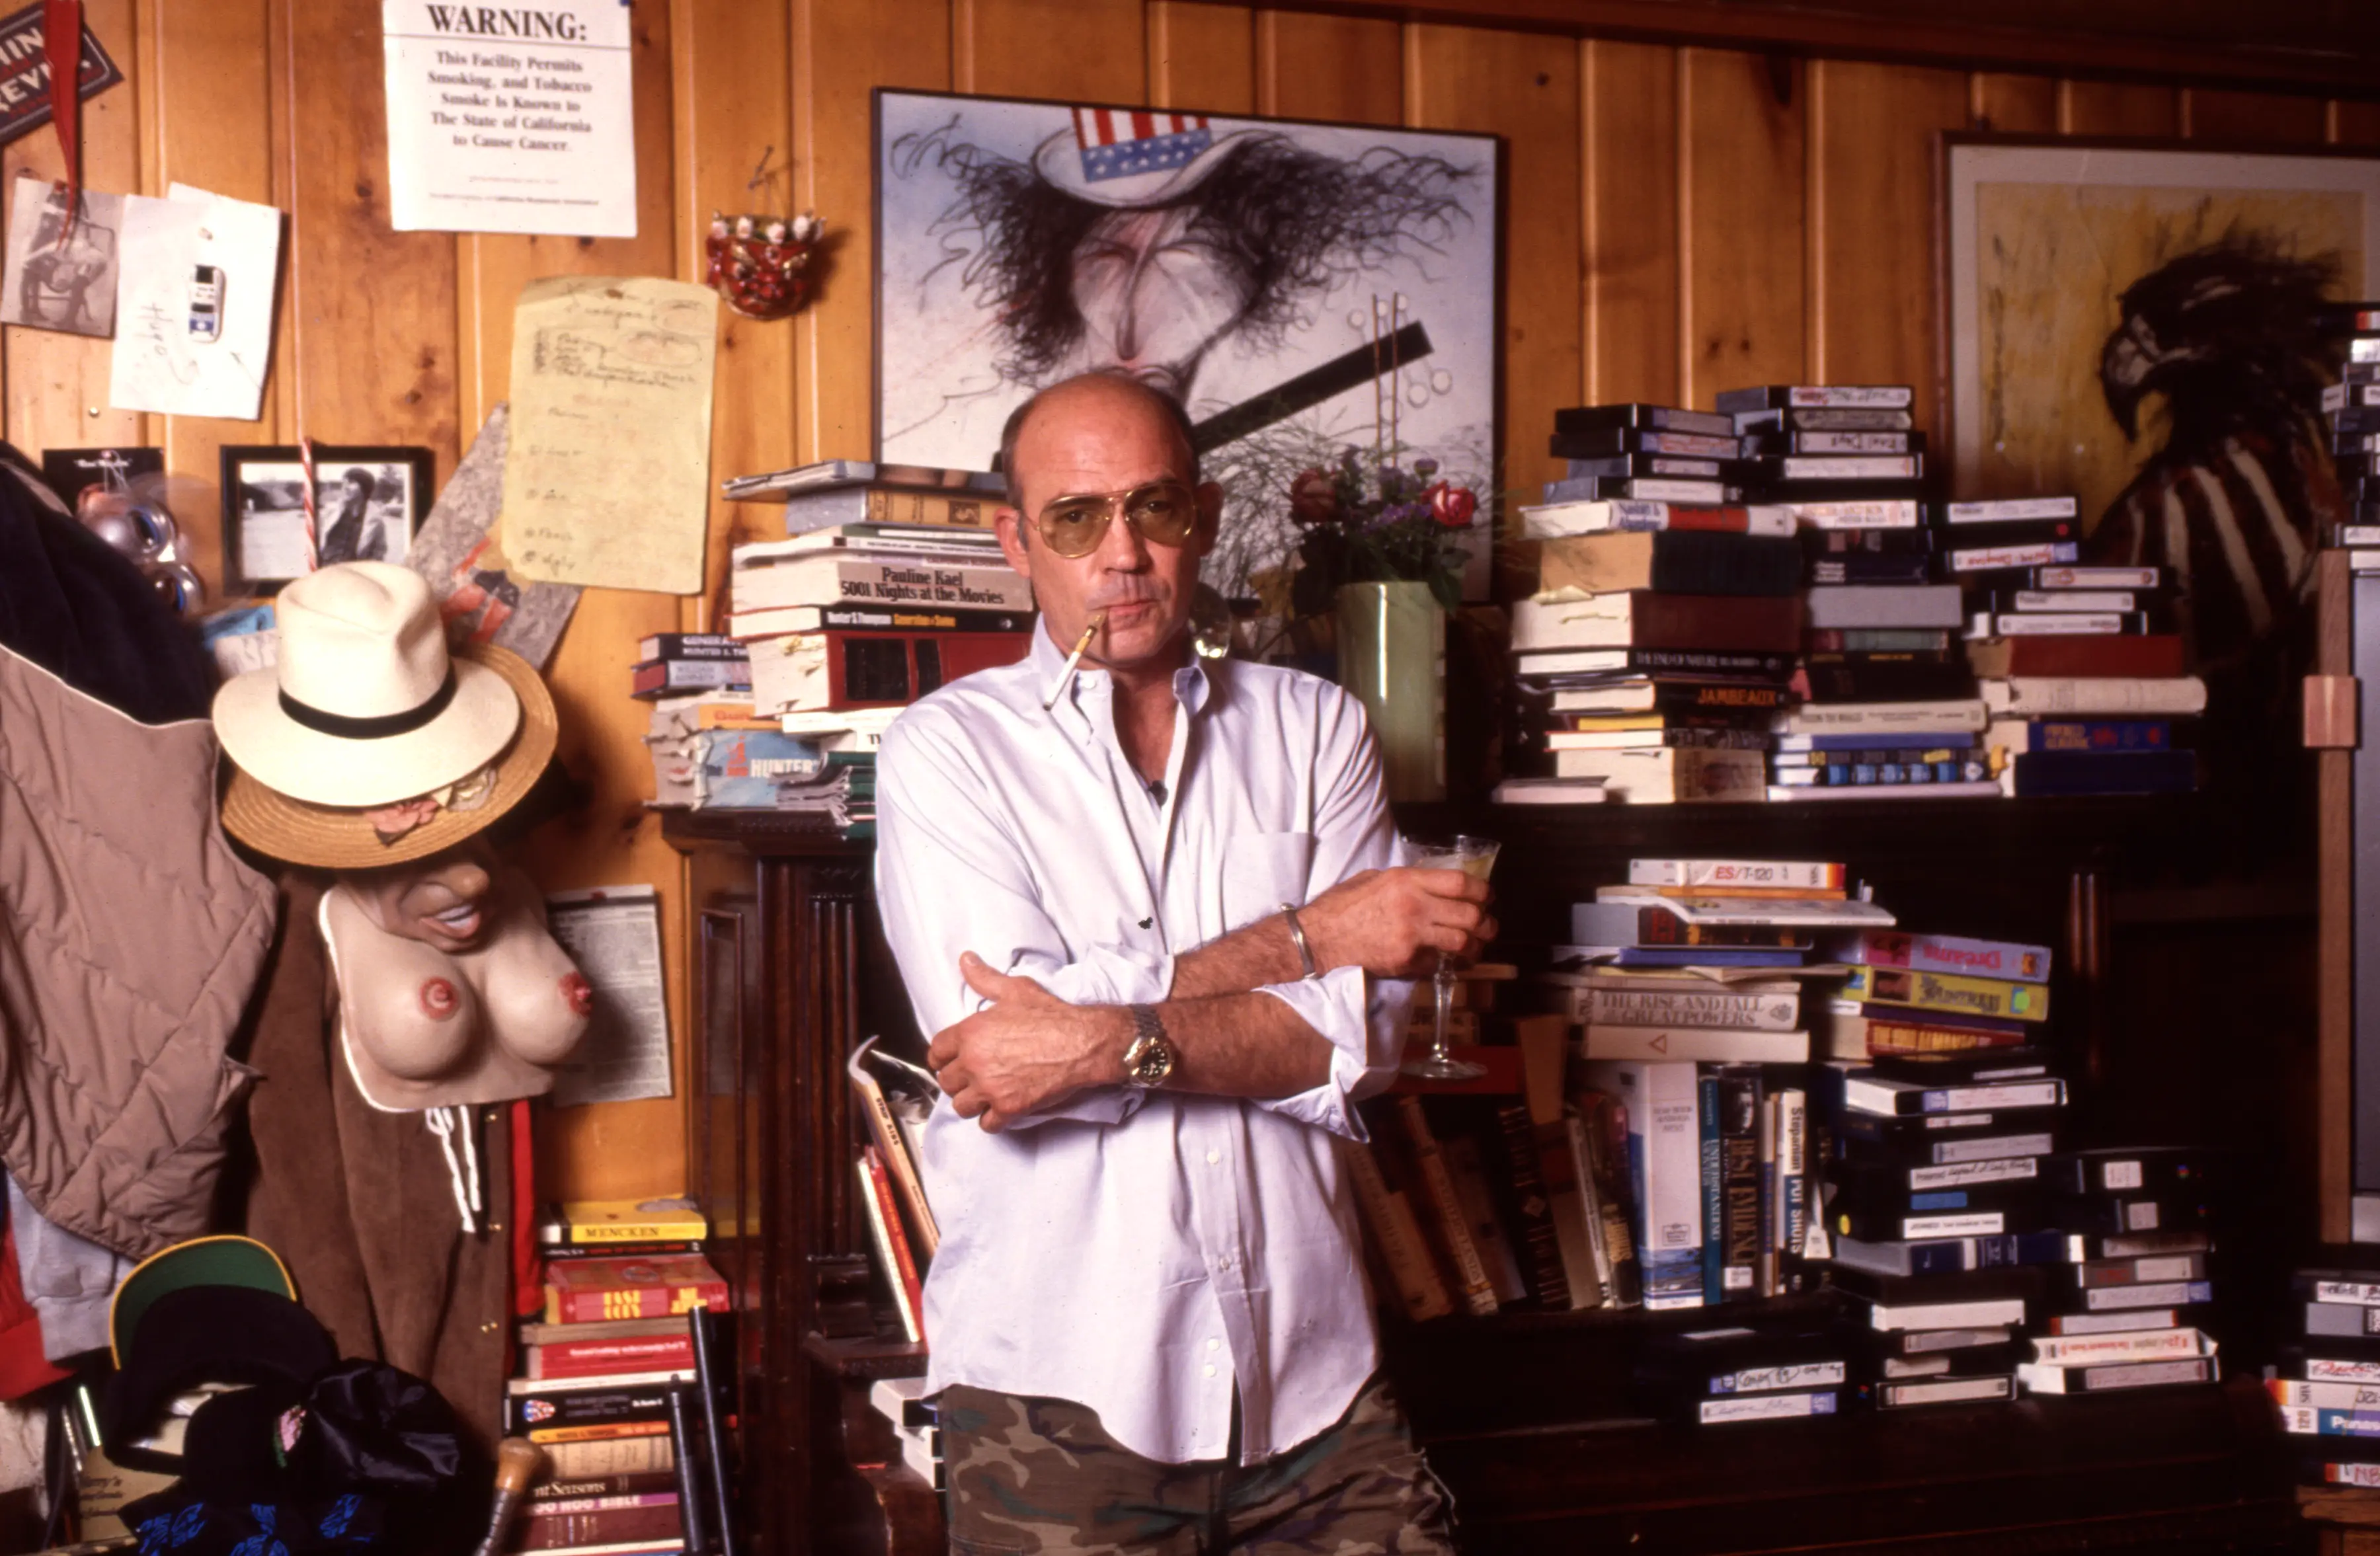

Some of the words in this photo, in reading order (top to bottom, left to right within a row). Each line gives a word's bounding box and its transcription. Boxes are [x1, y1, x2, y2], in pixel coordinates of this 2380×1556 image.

[426, 4, 588, 41] WARNING:
[436, 50, 467, 64] This
[472, 52, 521, 70] Facility
[527, 57, 583, 71] Permits
[427, 71, 496, 89] Smoking,
[502, 77, 528, 89] and
[534, 77, 592, 93] Tobacco
[441, 93, 489, 107] Smoke
[513, 97, 561, 110] Known
[431, 112, 457, 126] The
[463, 114, 497, 128] State
[503, 116, 518, 128] of
[522, 118, 591, 133] California
[473, 135, 514, 149] Cause
[882, 567, 931, 584] Pauline
[935, 570, 963, 586] Kael
[842, 581, 871, 597] 5001
[875, 583, 918, 602] Nights
[920, 587, 933, 600] at
[935, 587, 956, 602] the
[959, 588, 1005, 604] Movies
[750, 759, 814, 778] HUNTER
[1923, 944, 2001, 970] Dreams
[1603, 993, 1632, 1009] THE
[1640, 993, 1677, 1010] RISE
[1685, 995, 1720, 1011] AND
[1622, 1009, 1680, 1023] GREAT
[1687, 1011, 1757, 1025] POWERS
[1789, 1106, 1804, 1171] Stepanian
[585, 1227, 660, 1238] MENCKEN
[551, 1481, 606, 1496] Seasons
